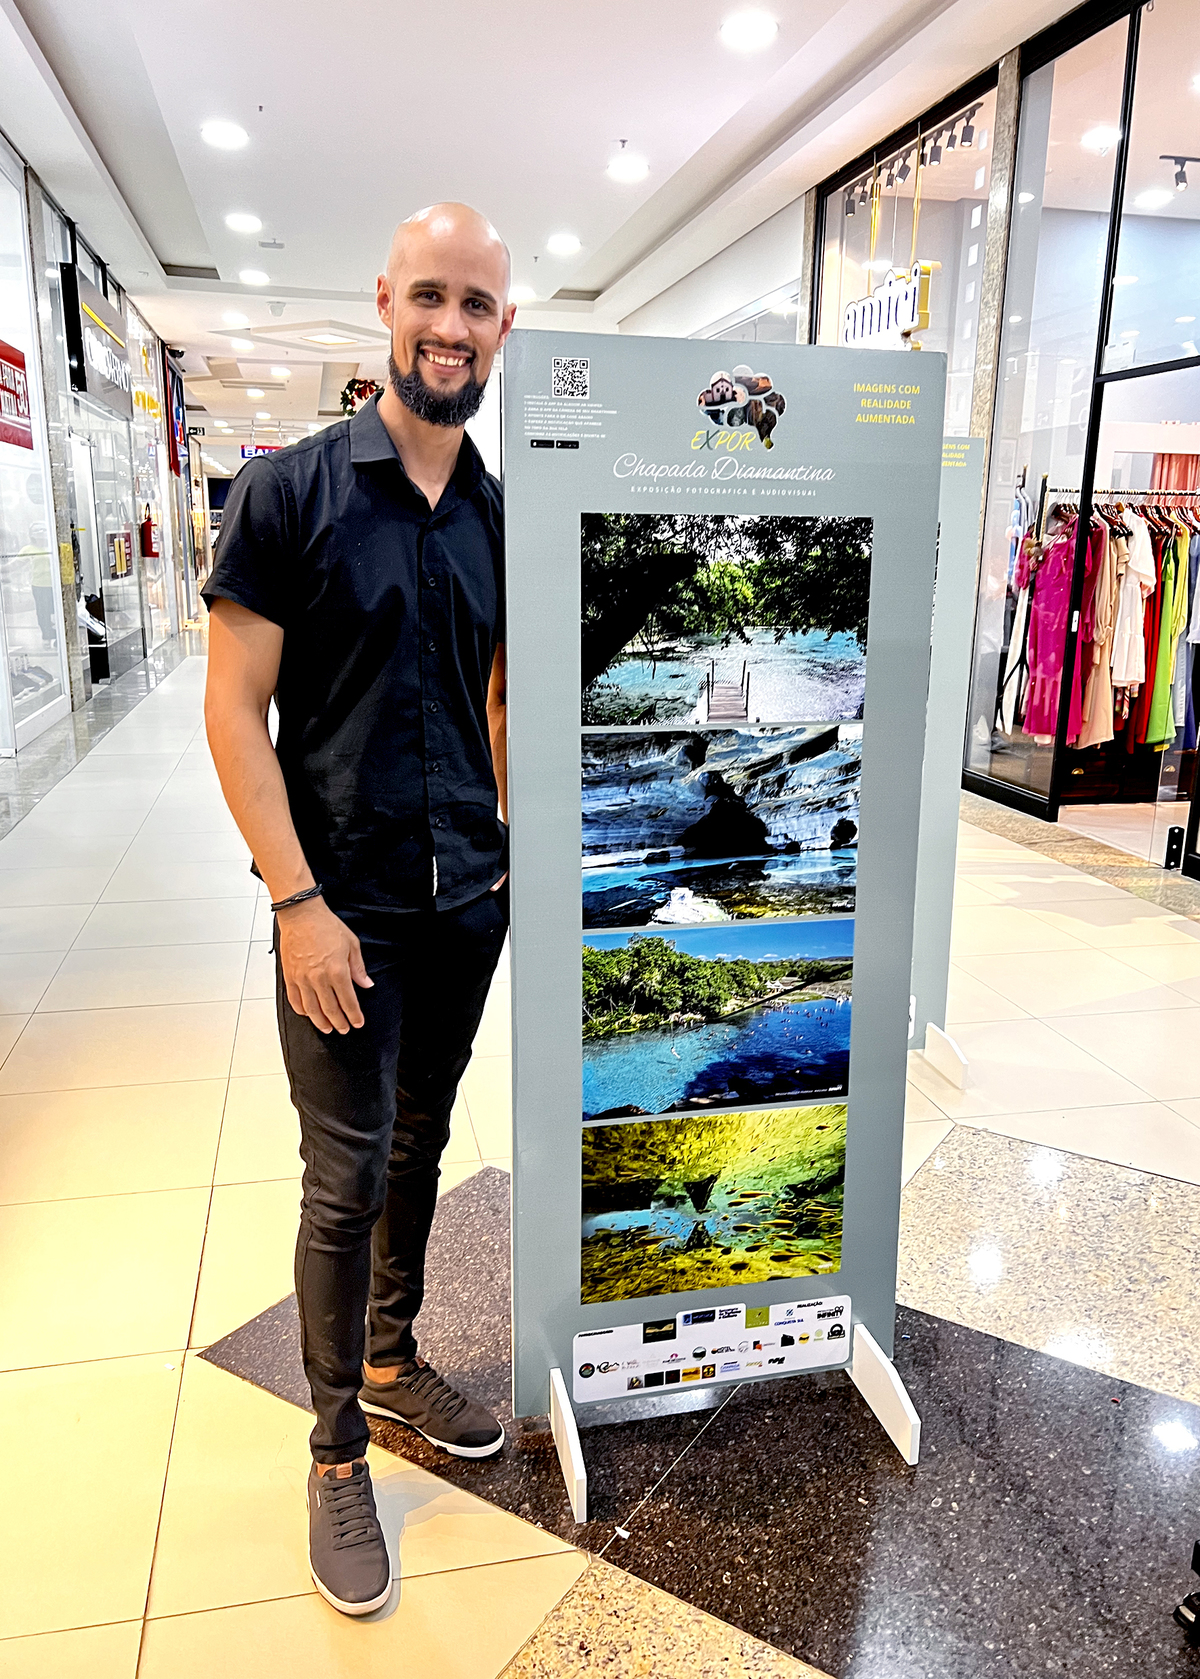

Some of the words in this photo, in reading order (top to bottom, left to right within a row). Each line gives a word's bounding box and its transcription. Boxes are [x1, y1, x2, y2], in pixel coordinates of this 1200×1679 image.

[853, 383, 896, 394] IMAGENS
[898, 385, 920, 394] COM
[861, 399, 911, 409] REALIDADE
[855, 413, 915, 424] AUMENTADA
[691, 429, 756, 451] EXPOR
[613, 452, 708, 482] Chapada
[711, 456, 836, 482] Diamantina
[631, 485, 682, 494] EXPOSIÇÃO
[686, 487, 748, 495] FOTOGRAFICA
[751, 488, 757, 496] E
[760, 488, 817, 497] AUDIOVISUAL
